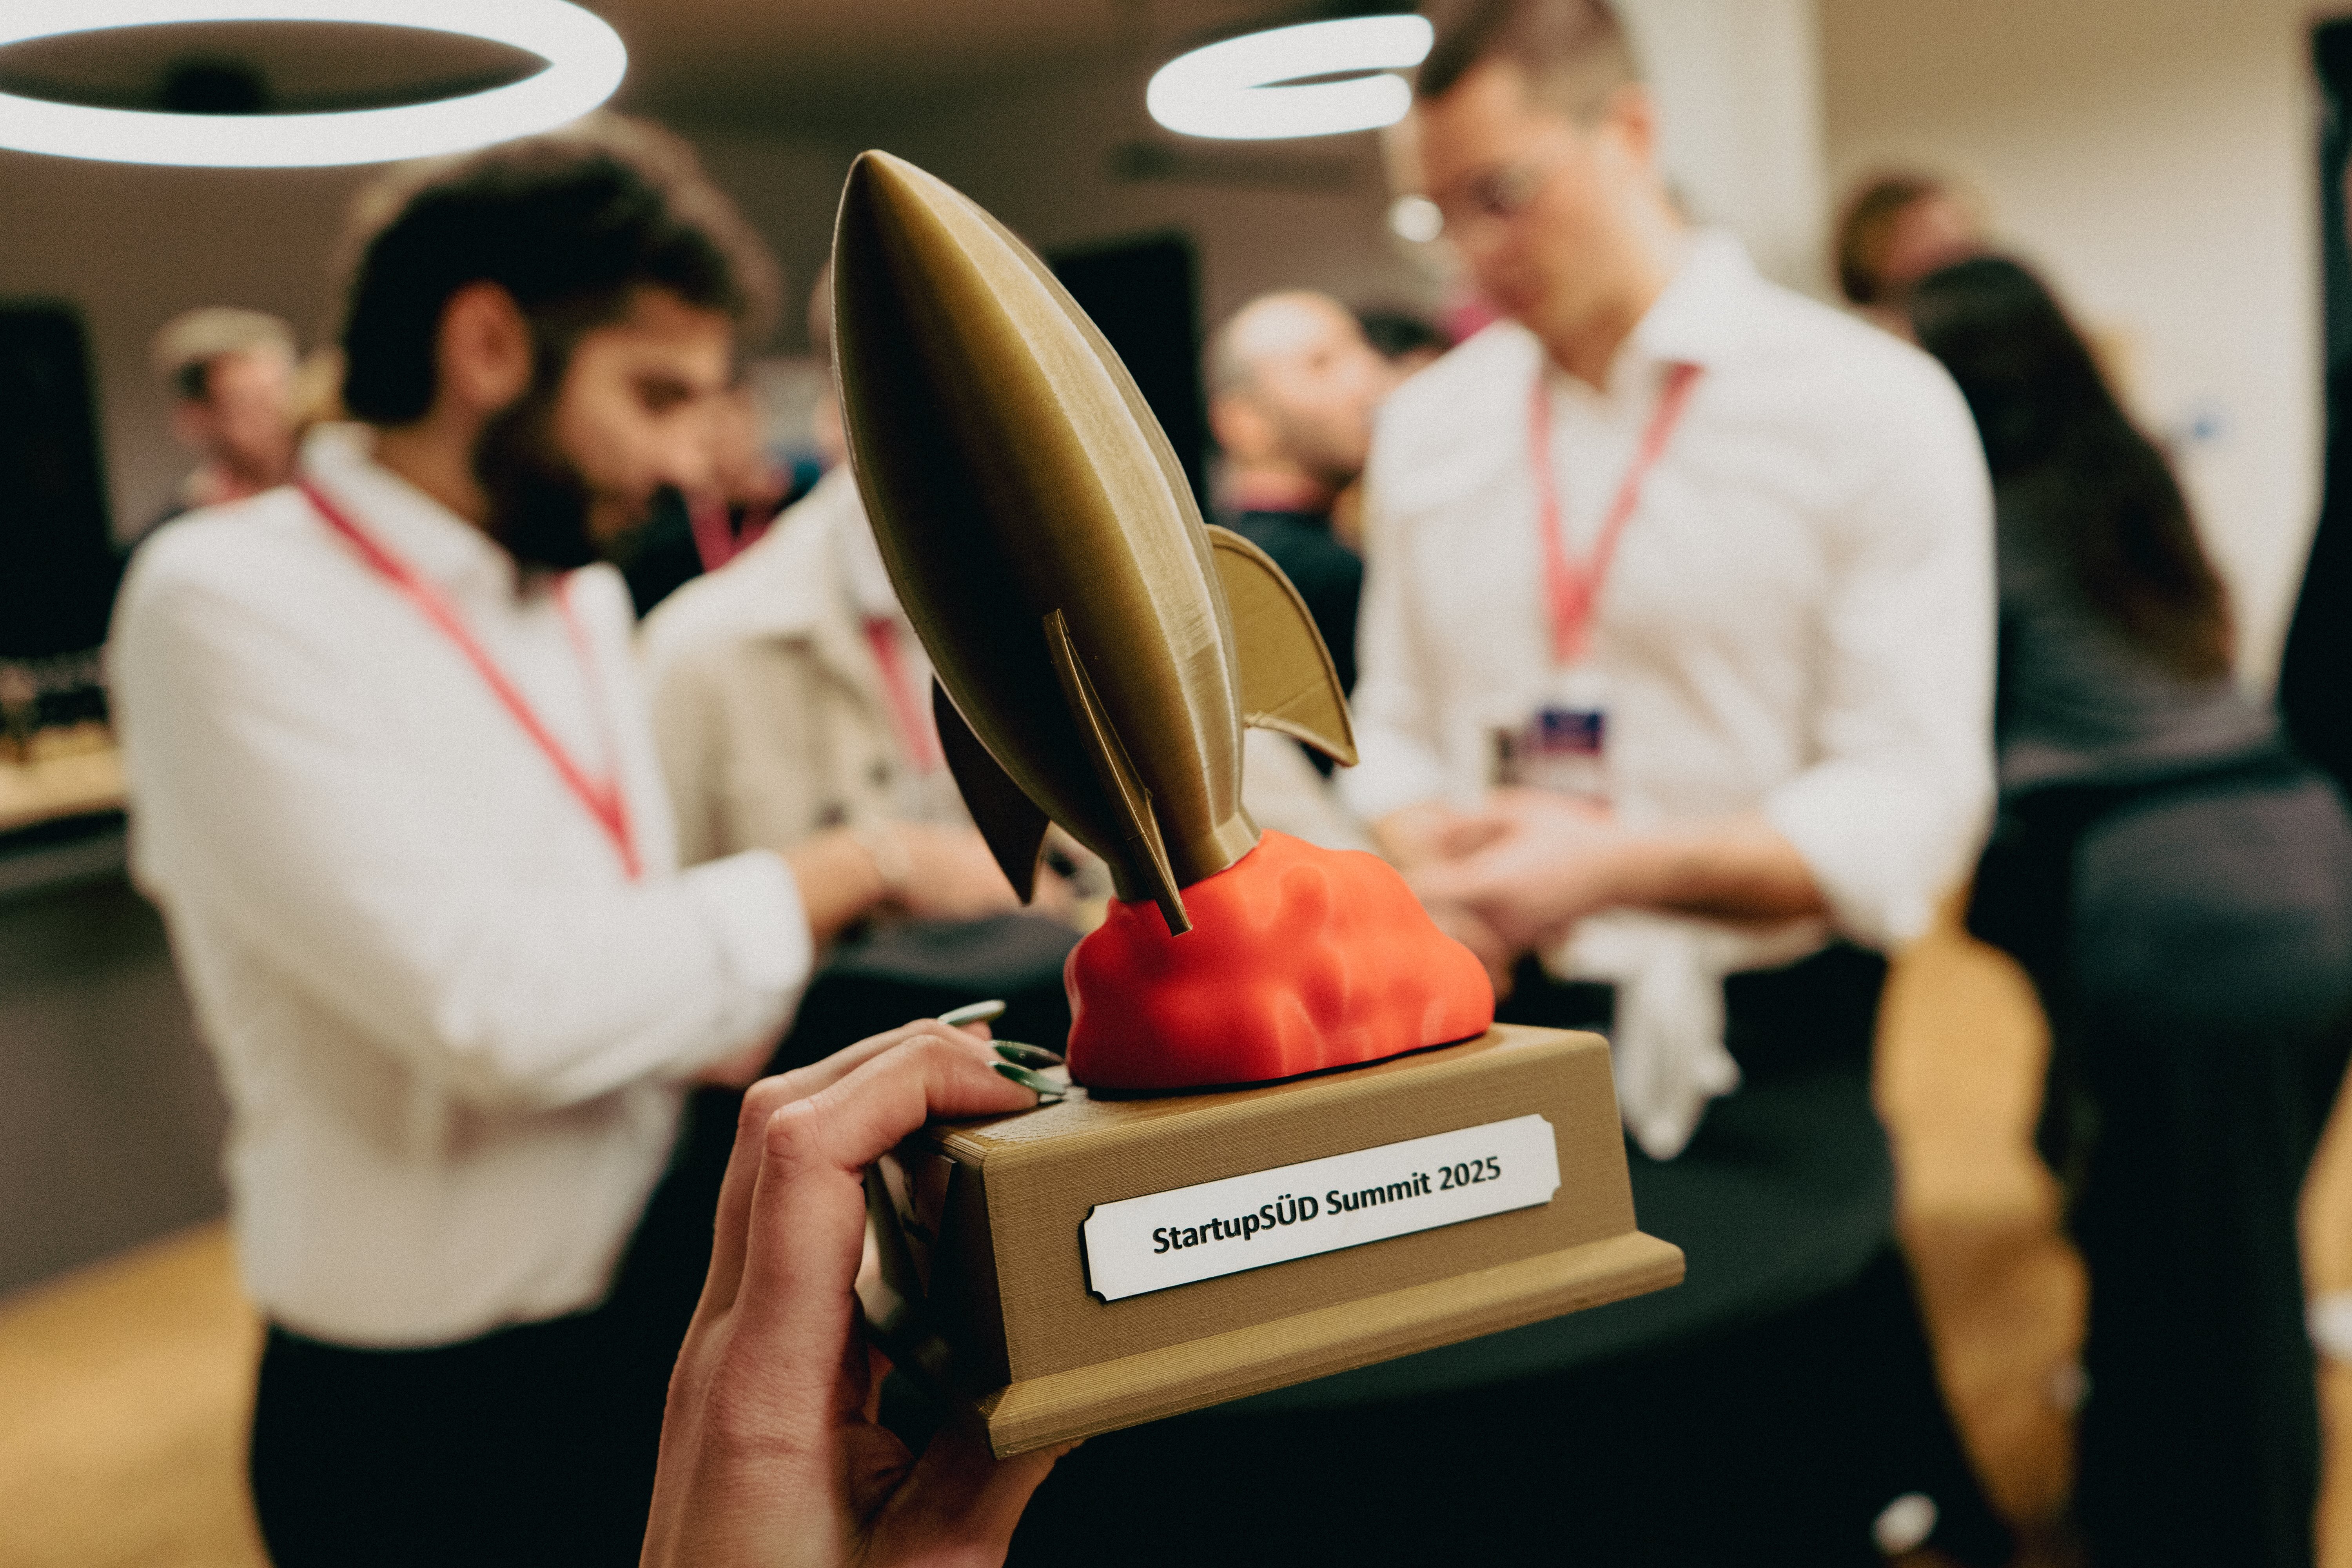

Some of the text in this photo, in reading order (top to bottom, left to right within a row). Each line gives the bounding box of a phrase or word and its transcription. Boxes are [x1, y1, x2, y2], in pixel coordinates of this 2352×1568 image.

[1152, 1155, 1501, 1254] StartupSÜD Summit 2025
